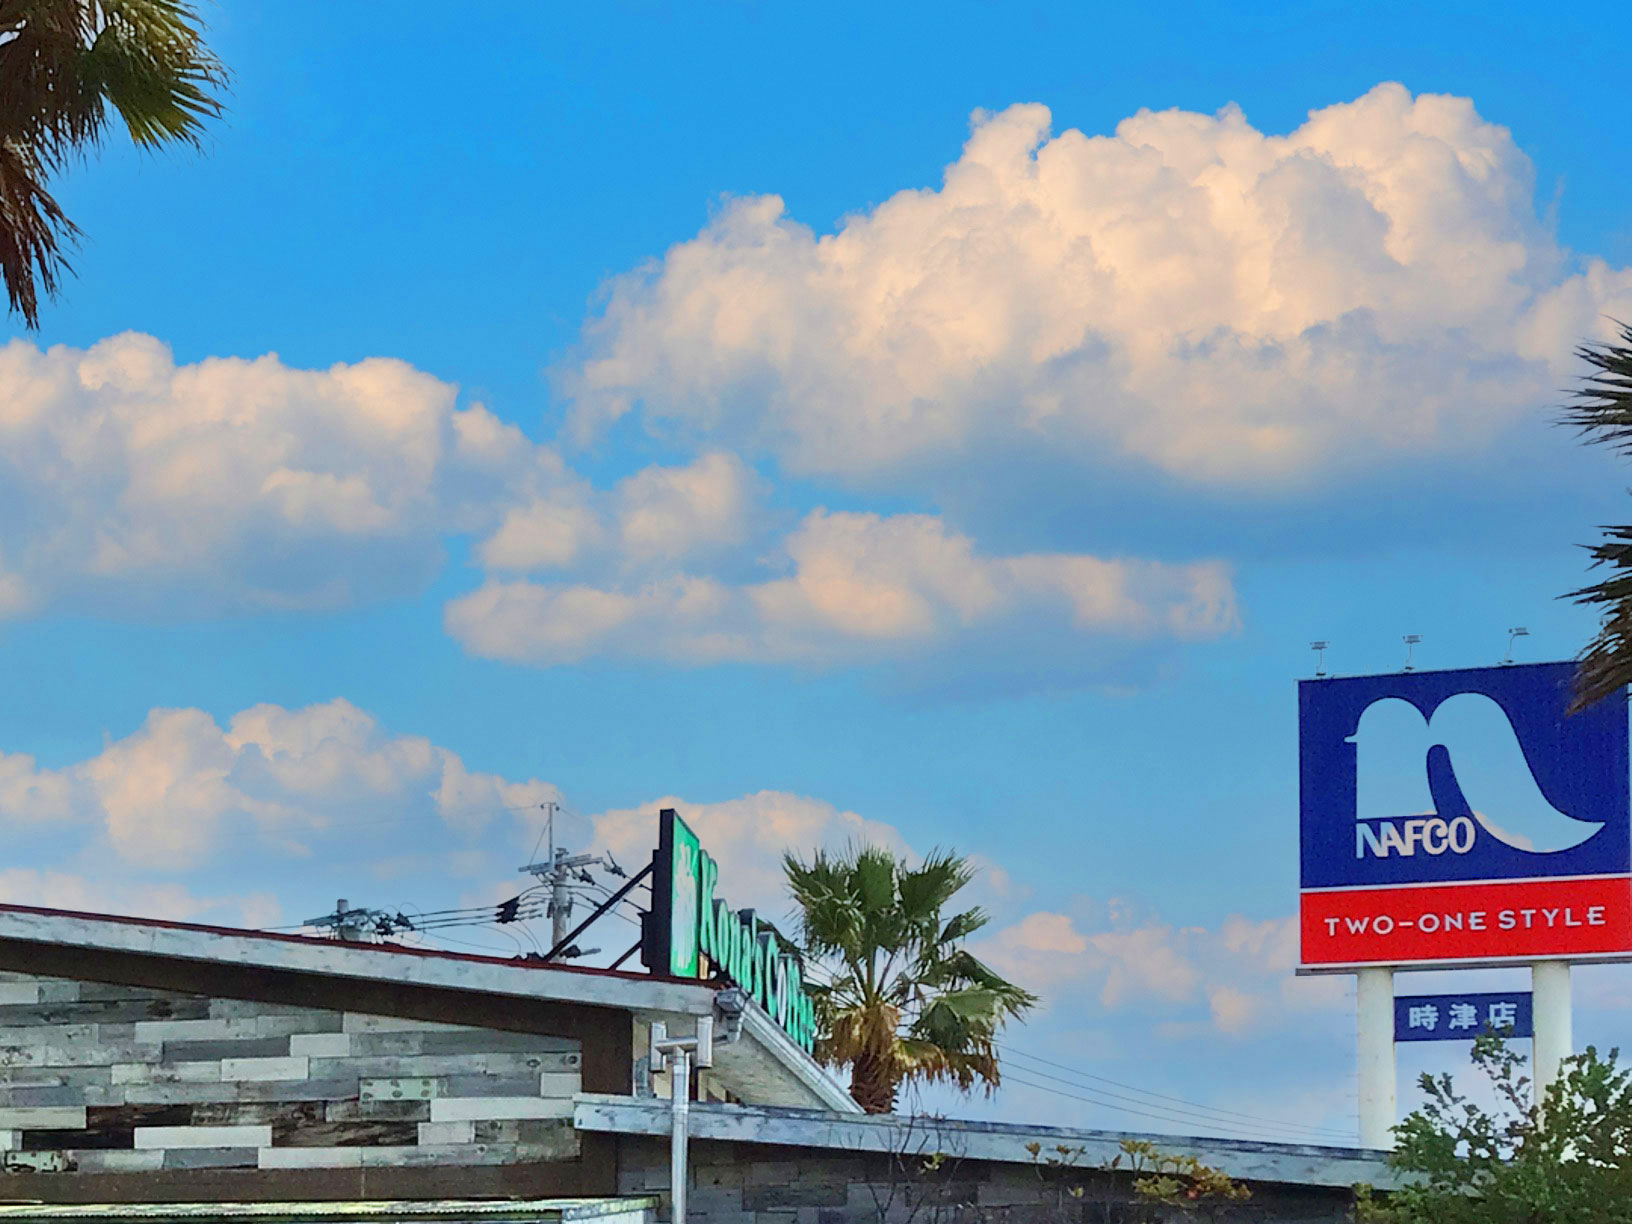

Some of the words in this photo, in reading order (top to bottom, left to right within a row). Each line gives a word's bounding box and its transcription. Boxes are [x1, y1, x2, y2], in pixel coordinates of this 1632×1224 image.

[1356, 816, 1475, 858] NAFCO
[700, 849, 764, 1006] Kona's
[1325, 912, 1487, 936] TWO-ONE
[1498, 906, 1606, 929] STYLE
[1409, 1001, 1517, 1031] 時津店
